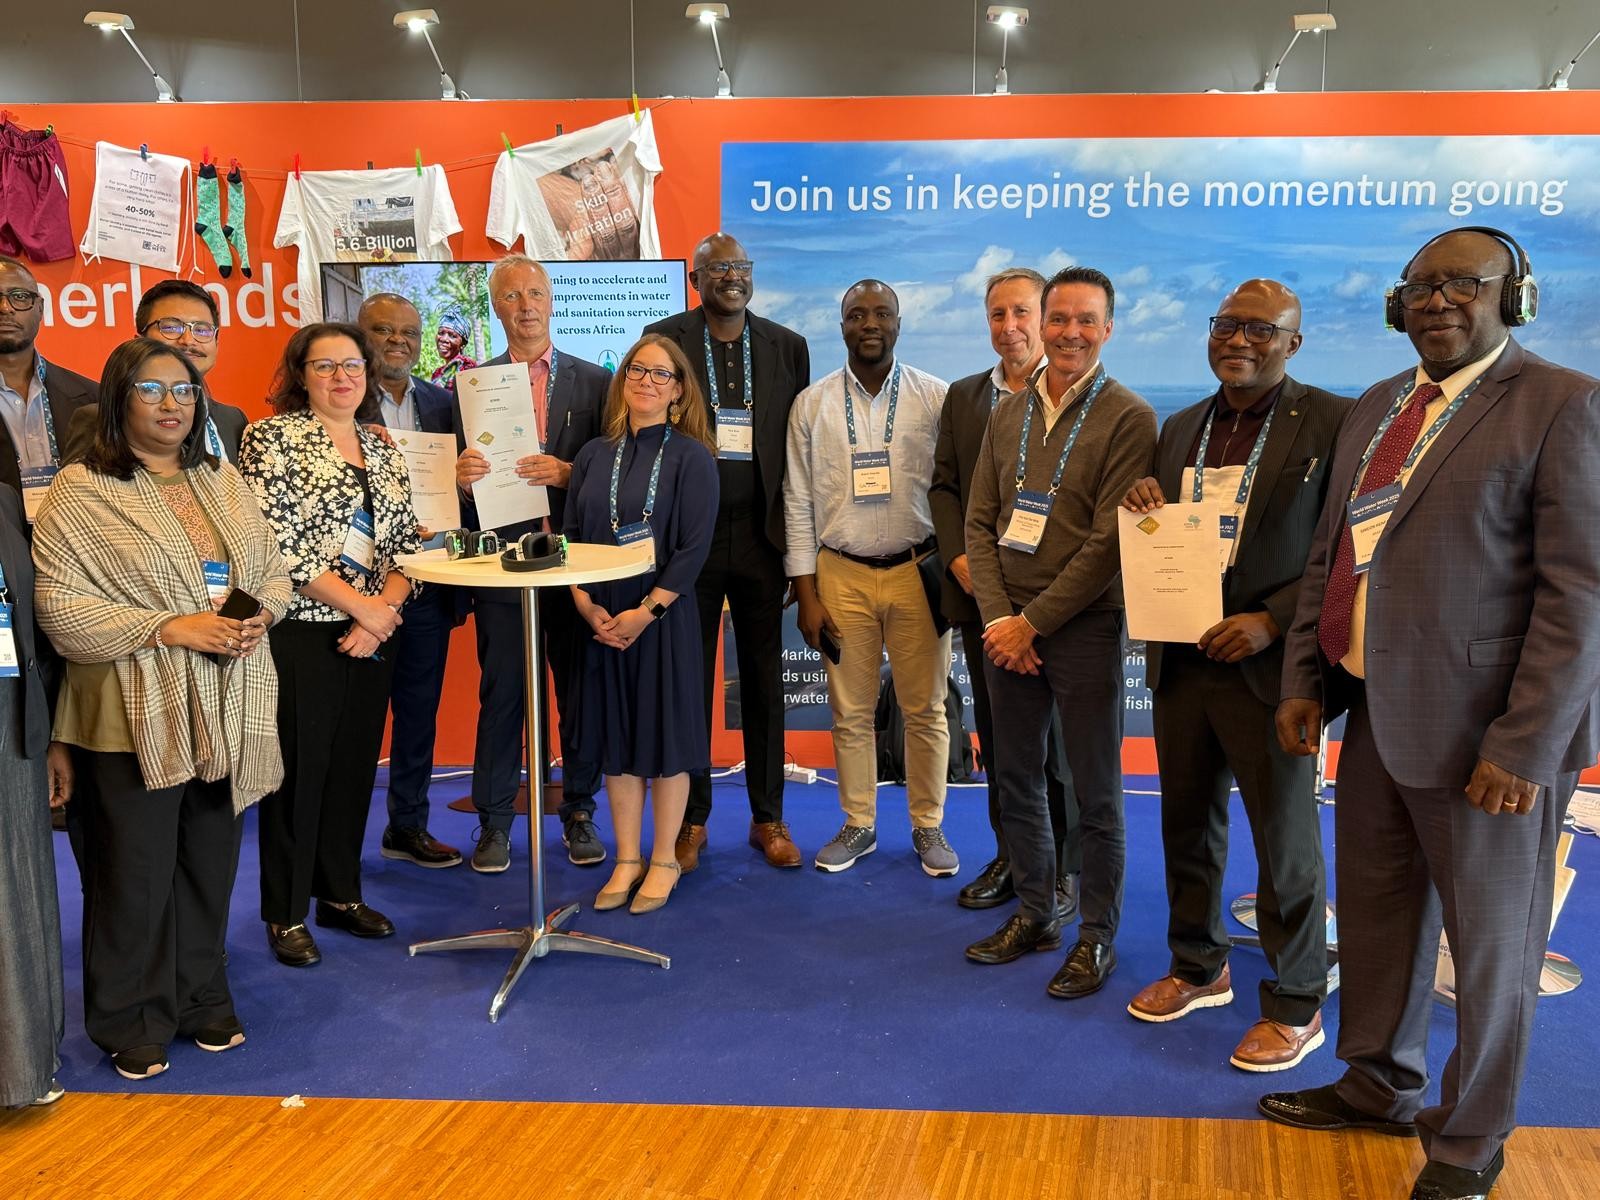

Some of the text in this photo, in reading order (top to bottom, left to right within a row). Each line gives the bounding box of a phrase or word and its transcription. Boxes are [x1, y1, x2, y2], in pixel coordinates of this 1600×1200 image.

[575, 191, 609, 213] Skin
[750, 171, 1568, 219] Join us in keeping the momentum going
[125, 205, 156, 218] 40-50%
[566, 207, 633, 241] Irritation
[336, 234, 415, 251] 5.6 Billion
[578, 275, 590, 284] to
[592, 274, 645, 284] accelerate
[647, 274, 667, 284] and
[628, 291, 639, 300] in
[570, 308, 625, 318] sanitation
[626, 308, 669, 317] services
[592, 325, 626, 334] Africa
[782, 669, 798, 682] ds
[1126, 677, 1142, 688] er
[1125, 696, 1152, 710] fish
